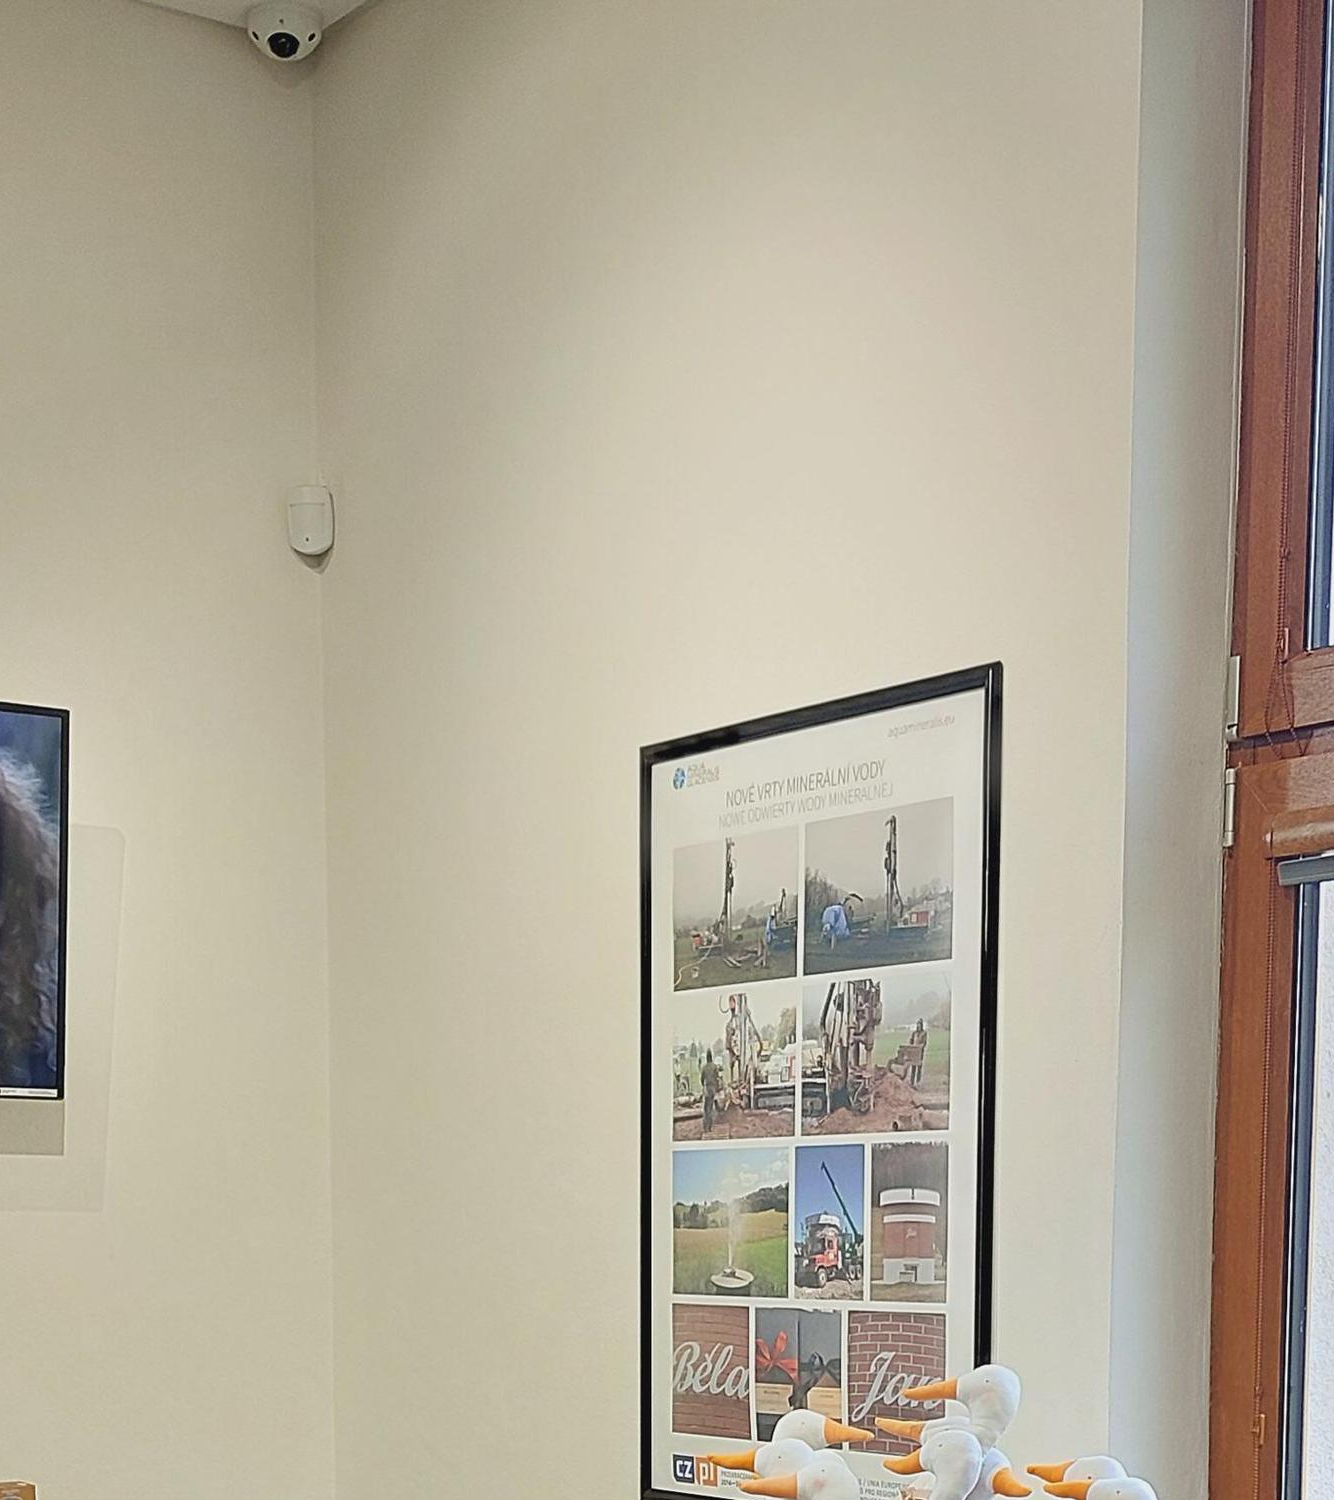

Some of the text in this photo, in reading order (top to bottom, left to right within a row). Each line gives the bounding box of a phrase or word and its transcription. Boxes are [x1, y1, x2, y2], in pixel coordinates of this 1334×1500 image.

[725, 758, 885, 808] NOVÉ VRTY MINERÁLNÍ VODY
[671, 1340, 749, 1399] Běla
[675, 1461, 694, 1479] cz
